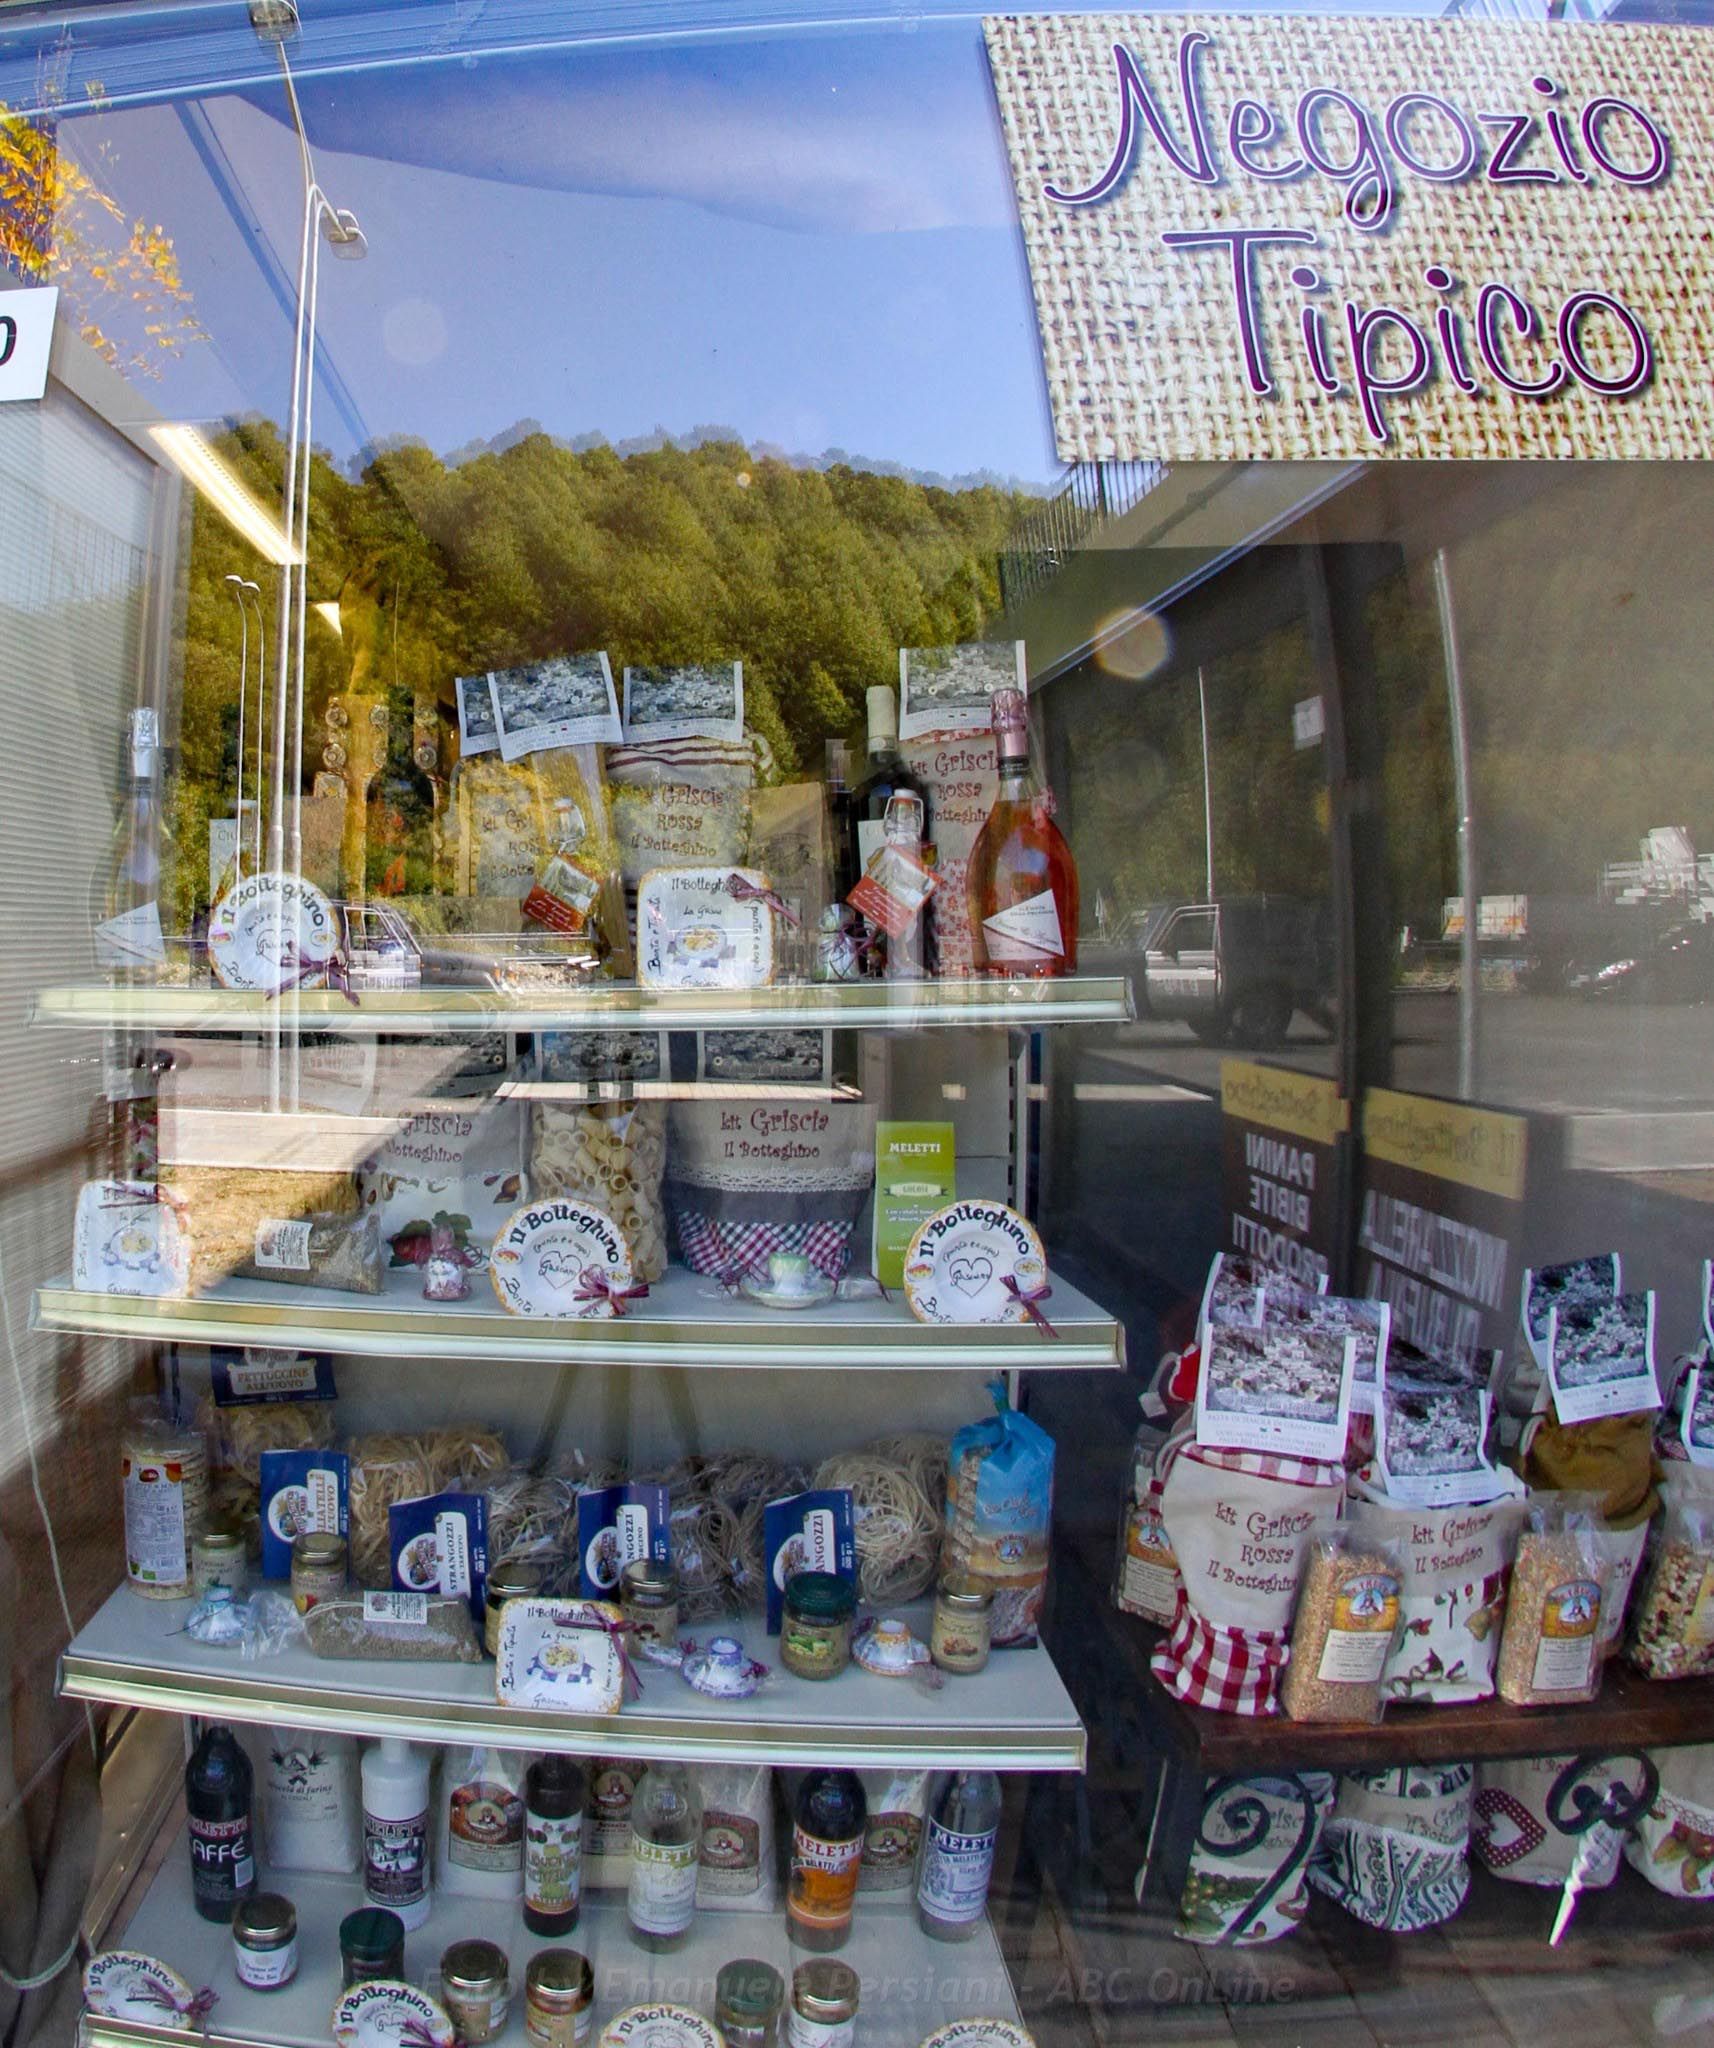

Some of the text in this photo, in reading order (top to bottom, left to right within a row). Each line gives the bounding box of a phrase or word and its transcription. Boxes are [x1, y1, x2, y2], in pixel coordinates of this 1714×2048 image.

[1043, 30, 1671, 230] Negozio
[1161, 227, 1656, 443] Tipico
[934, 750, 999, 777] Grisci
[681, 876, 732, 897] Bottegh
[719, 1107, 831, 1138] kit Griscia
[723, 1141, 821, 1162] Il Botteghino
[888, 1142, 942, 1155] MELETTI
[510, 1204, 620, 1264] Il Botteghino
[919, 1240, 936, 1258] Il
[928, 1204, 1030, 1256] Botteghino
[316, 1473, 327, 1533] LIATELLE
[1215, 1500, 1238, 1526] kit
[624, 1513, 636, 1561] NGOZZI
[812, 1514, 825, 1572] ANGOZZI
[1411, 1523, 1435, 1545] kit
[445, 1522, 458, 1592] STRANGOZZI
[1205, 1558, 1219, 1579] Il
[1239, 1543, 1296, 1568] Rossa
[1414, 1556, 1426, 1575] Il
[192, 1834, 246, 1865] AFFÉ
[934, 1828, 996, 1851] MELET
[94, 1955, 176, 1989] Botteghino
[343, 1985, 434, 2019] Botteghino
